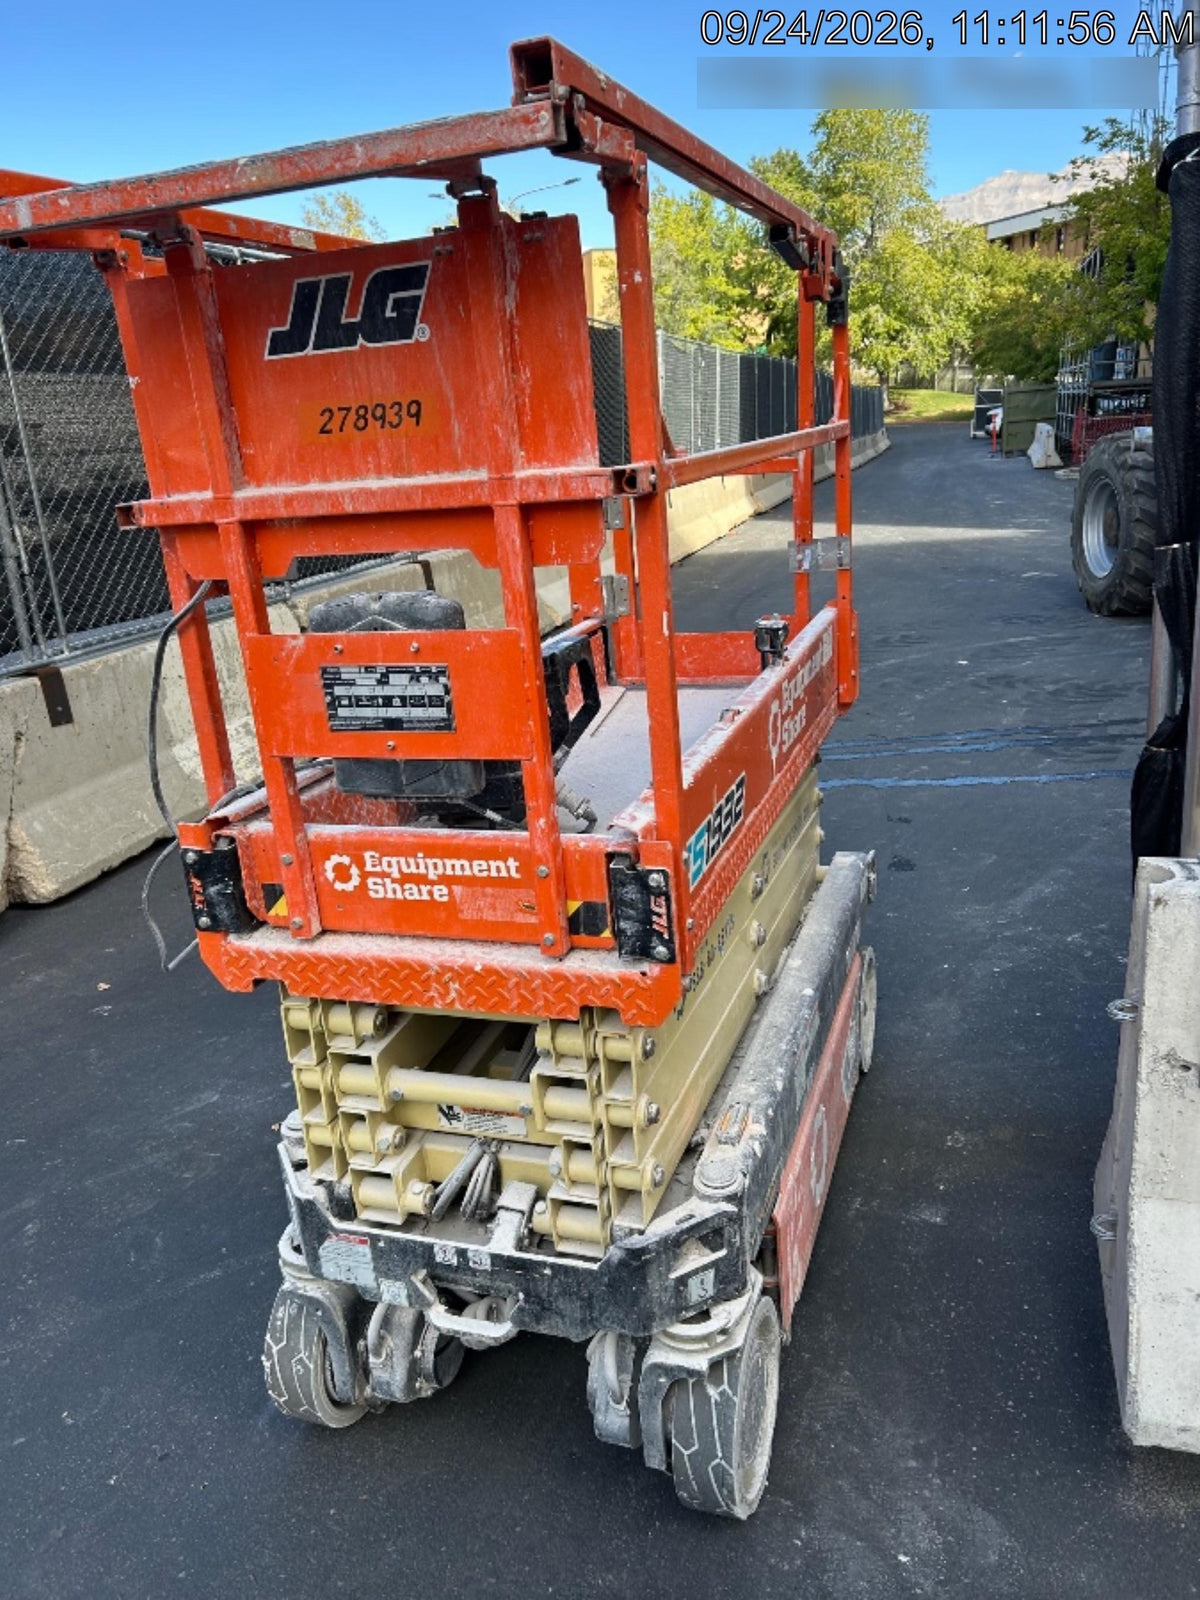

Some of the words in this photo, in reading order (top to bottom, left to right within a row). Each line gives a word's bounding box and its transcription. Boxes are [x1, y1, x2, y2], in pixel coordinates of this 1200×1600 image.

[318, 399, 422, 435] 278939
[363, 851, 521, 880] Equipment
[366, 878, 449, 902] Share
